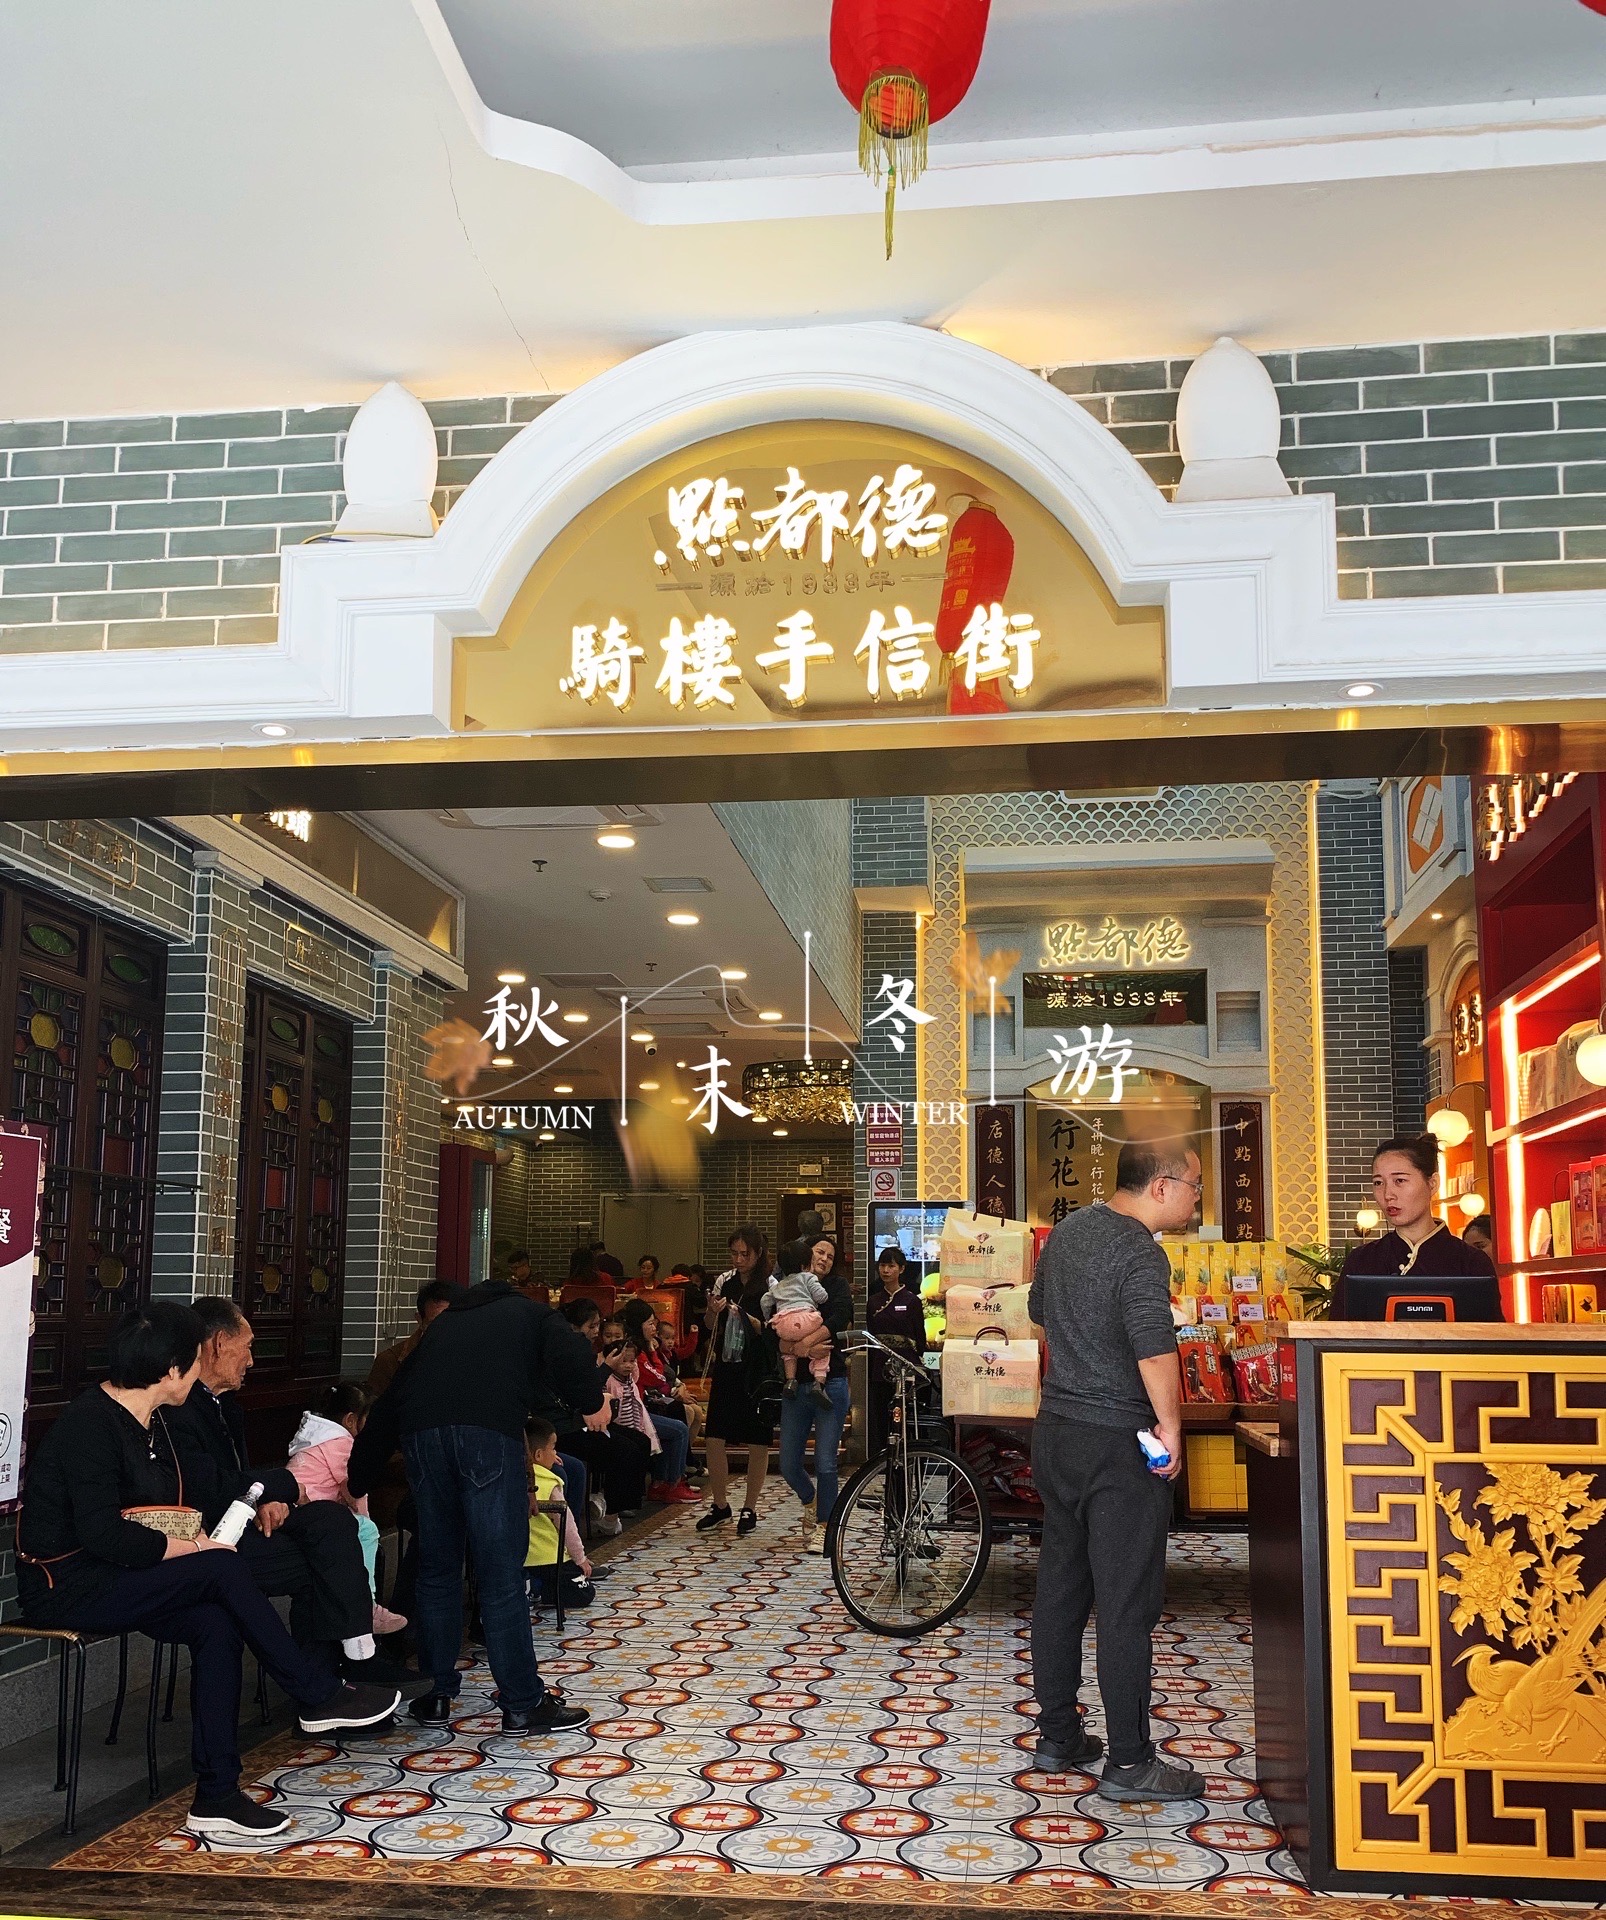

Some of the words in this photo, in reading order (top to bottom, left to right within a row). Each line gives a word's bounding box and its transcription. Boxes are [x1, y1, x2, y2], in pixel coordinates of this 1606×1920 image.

[653, 464, 948, 572] 點都德
[560, 603, 1042, 711] 騎樓手信街
[1039, 917, 1191, 967] 點都德
